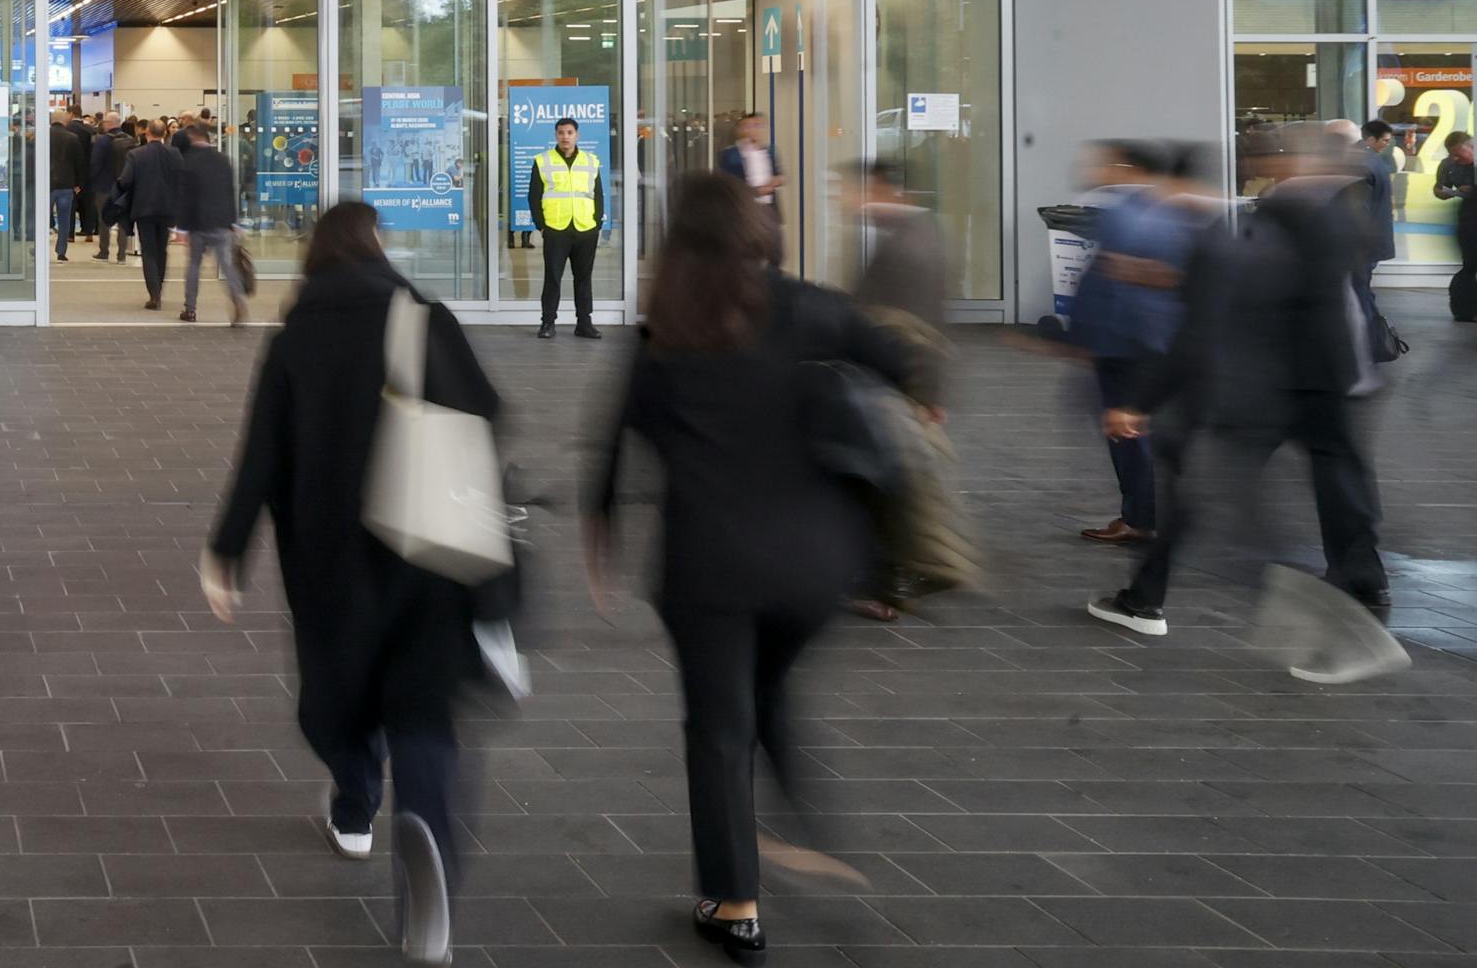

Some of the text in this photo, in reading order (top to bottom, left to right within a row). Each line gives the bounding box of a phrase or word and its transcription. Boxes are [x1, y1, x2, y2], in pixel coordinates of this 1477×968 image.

[1415, 71, 1473, 82] Garderobe
[381, 99, 444, 109] PLAST WORLD
[536, 103, 605, 119] ALLIANCE
[374, 198, 401, 207] MEMBER
[402, 198, 411, 206] OF
[422, 198, 453, 206] ALLIANCE
